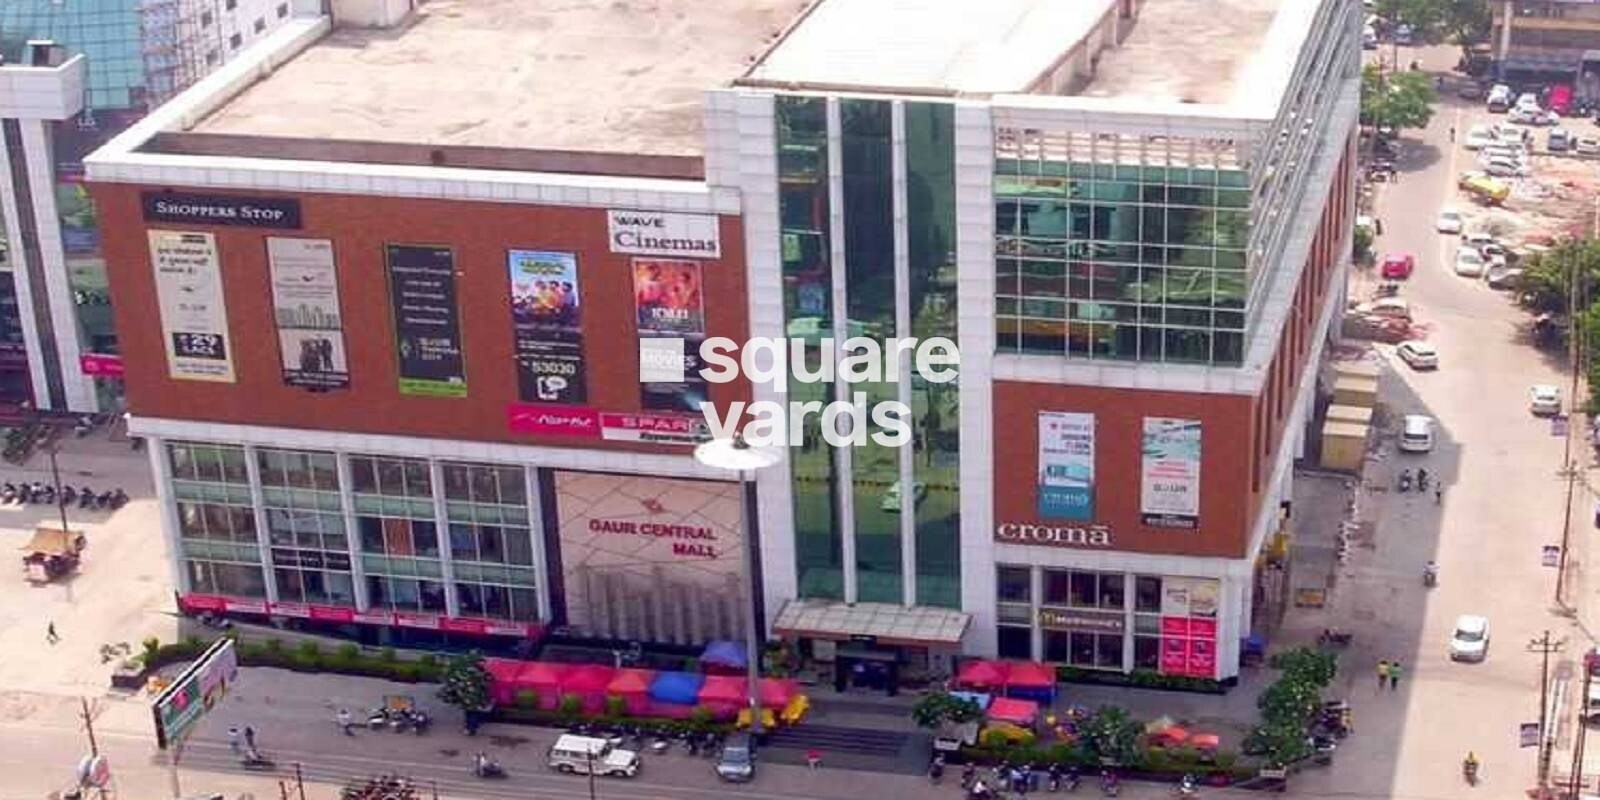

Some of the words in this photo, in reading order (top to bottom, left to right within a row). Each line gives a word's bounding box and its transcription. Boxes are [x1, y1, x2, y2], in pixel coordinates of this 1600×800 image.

[614, 216, 666, 228] WAVE
[614, 230, 716, 251] Cinemas
[621, 417, 688, 431] SPAR
[588, 519, 637, 535] GAUR
[640, 523, 718, 540] CENTRAL
[673, 543, 718, 559] MALL
